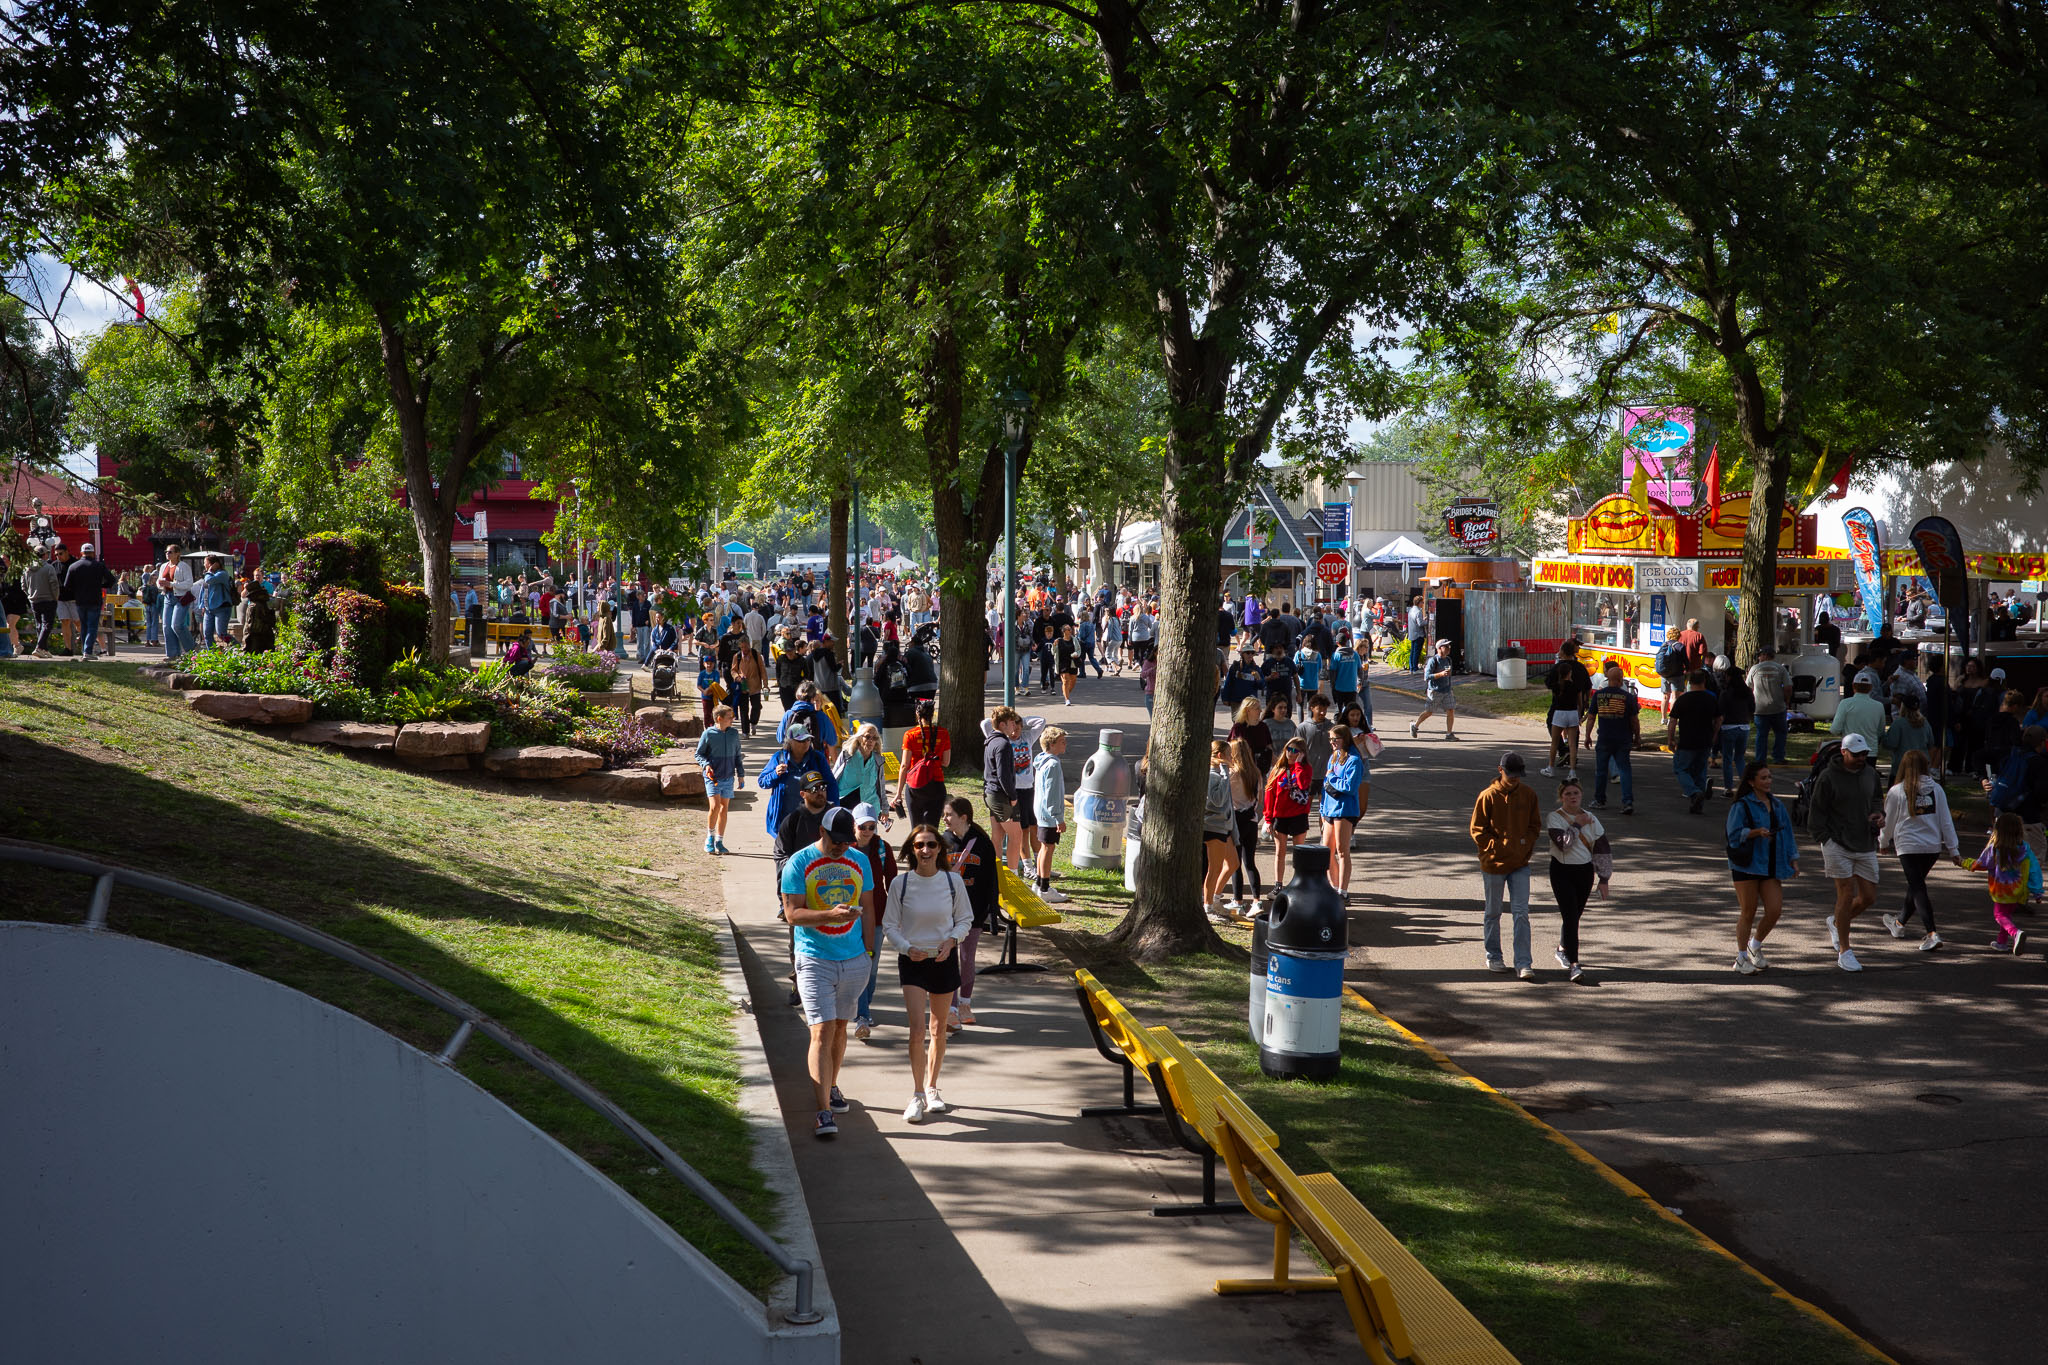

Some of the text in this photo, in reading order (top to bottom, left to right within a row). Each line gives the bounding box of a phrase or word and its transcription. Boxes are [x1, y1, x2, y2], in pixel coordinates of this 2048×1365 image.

[1449, 507, 1473, 519] BRIDGE
[1476, 506, 1500, 519] BARREL
[1463, 520, 1490, 533] Root
[1465, 530, 1492, 541] Beer
[1853, 539, 1875, 582] Spas
[1318, 562, 1346, 575] STOP
[1642, 566, 1693, 576] ICE COLD
[1560, 564, 1581, 584] LONG
[1582, 565, 1606, 586] HOT
[1607, 567, 1633, 588] DOG
[1646, 578, 1689, 587] DRINKS
[1798, 566, 1824, 586] DOG
[818, 622, 824, 634] 9
[1274, 975, 1291, 985] cans
